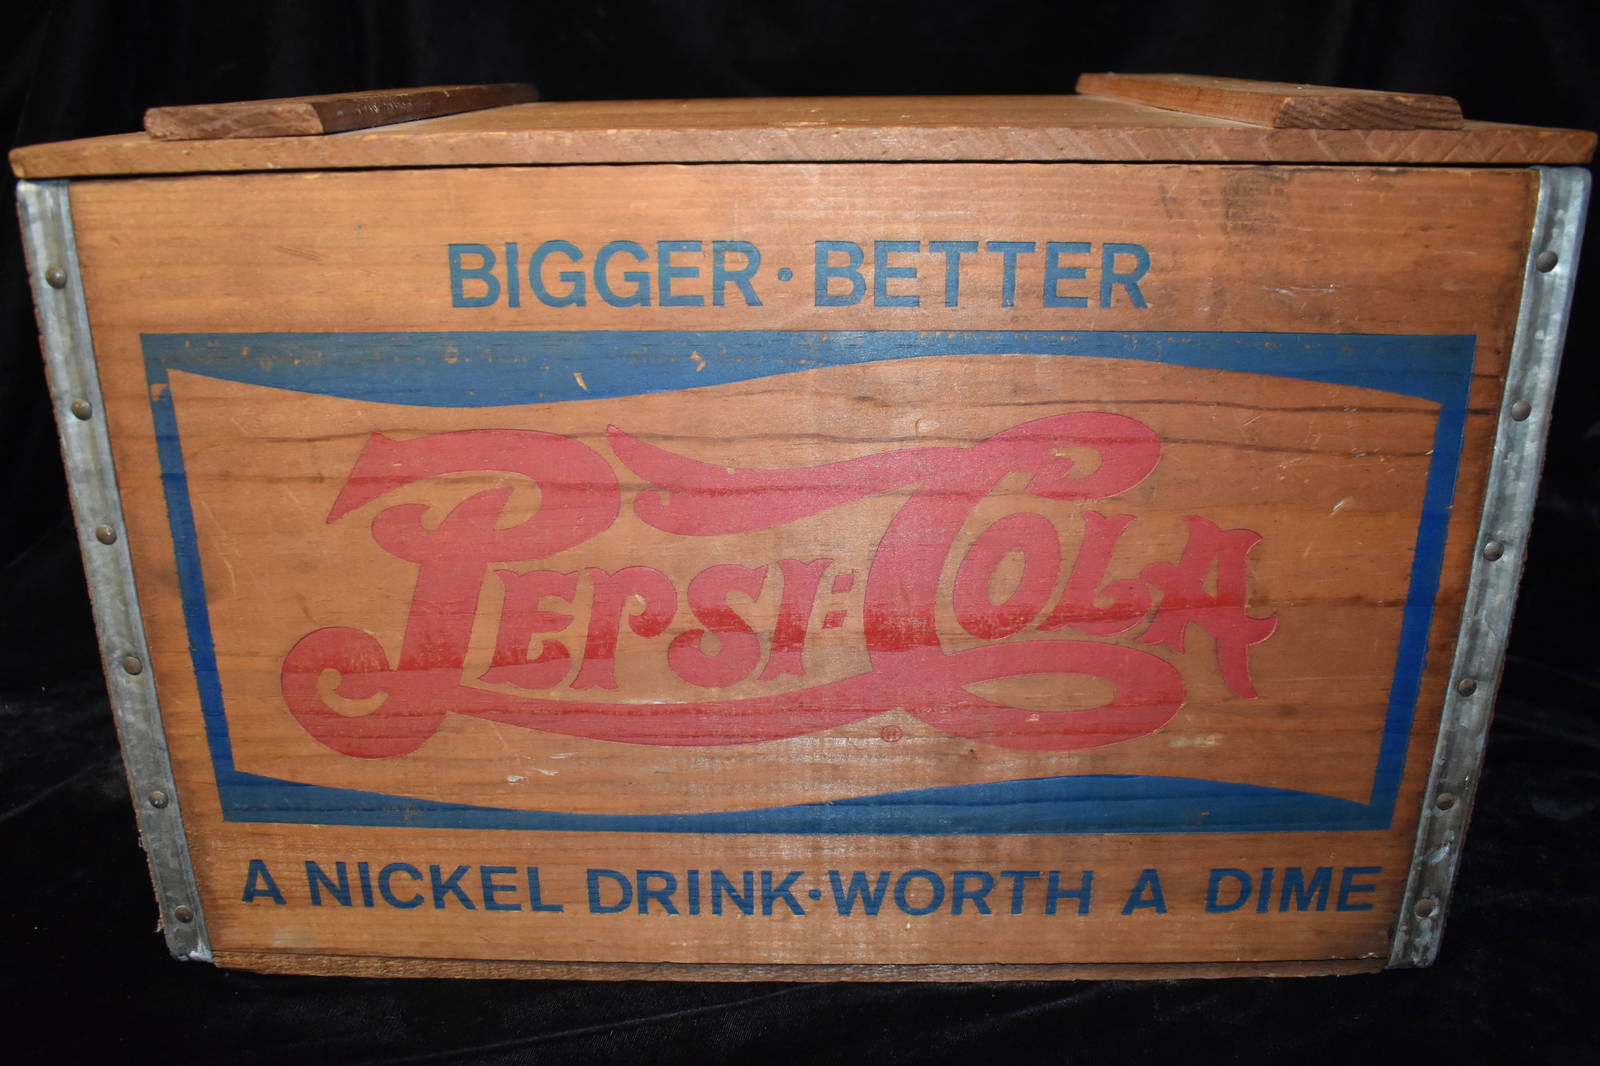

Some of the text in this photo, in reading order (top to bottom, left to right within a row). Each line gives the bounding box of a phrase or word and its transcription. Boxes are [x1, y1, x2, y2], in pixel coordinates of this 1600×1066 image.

[448, 239, 1152, 310] BIGGER BETTER
[242, 858, 1383, 917] A NICKEL DRINK WORTH A DIME
